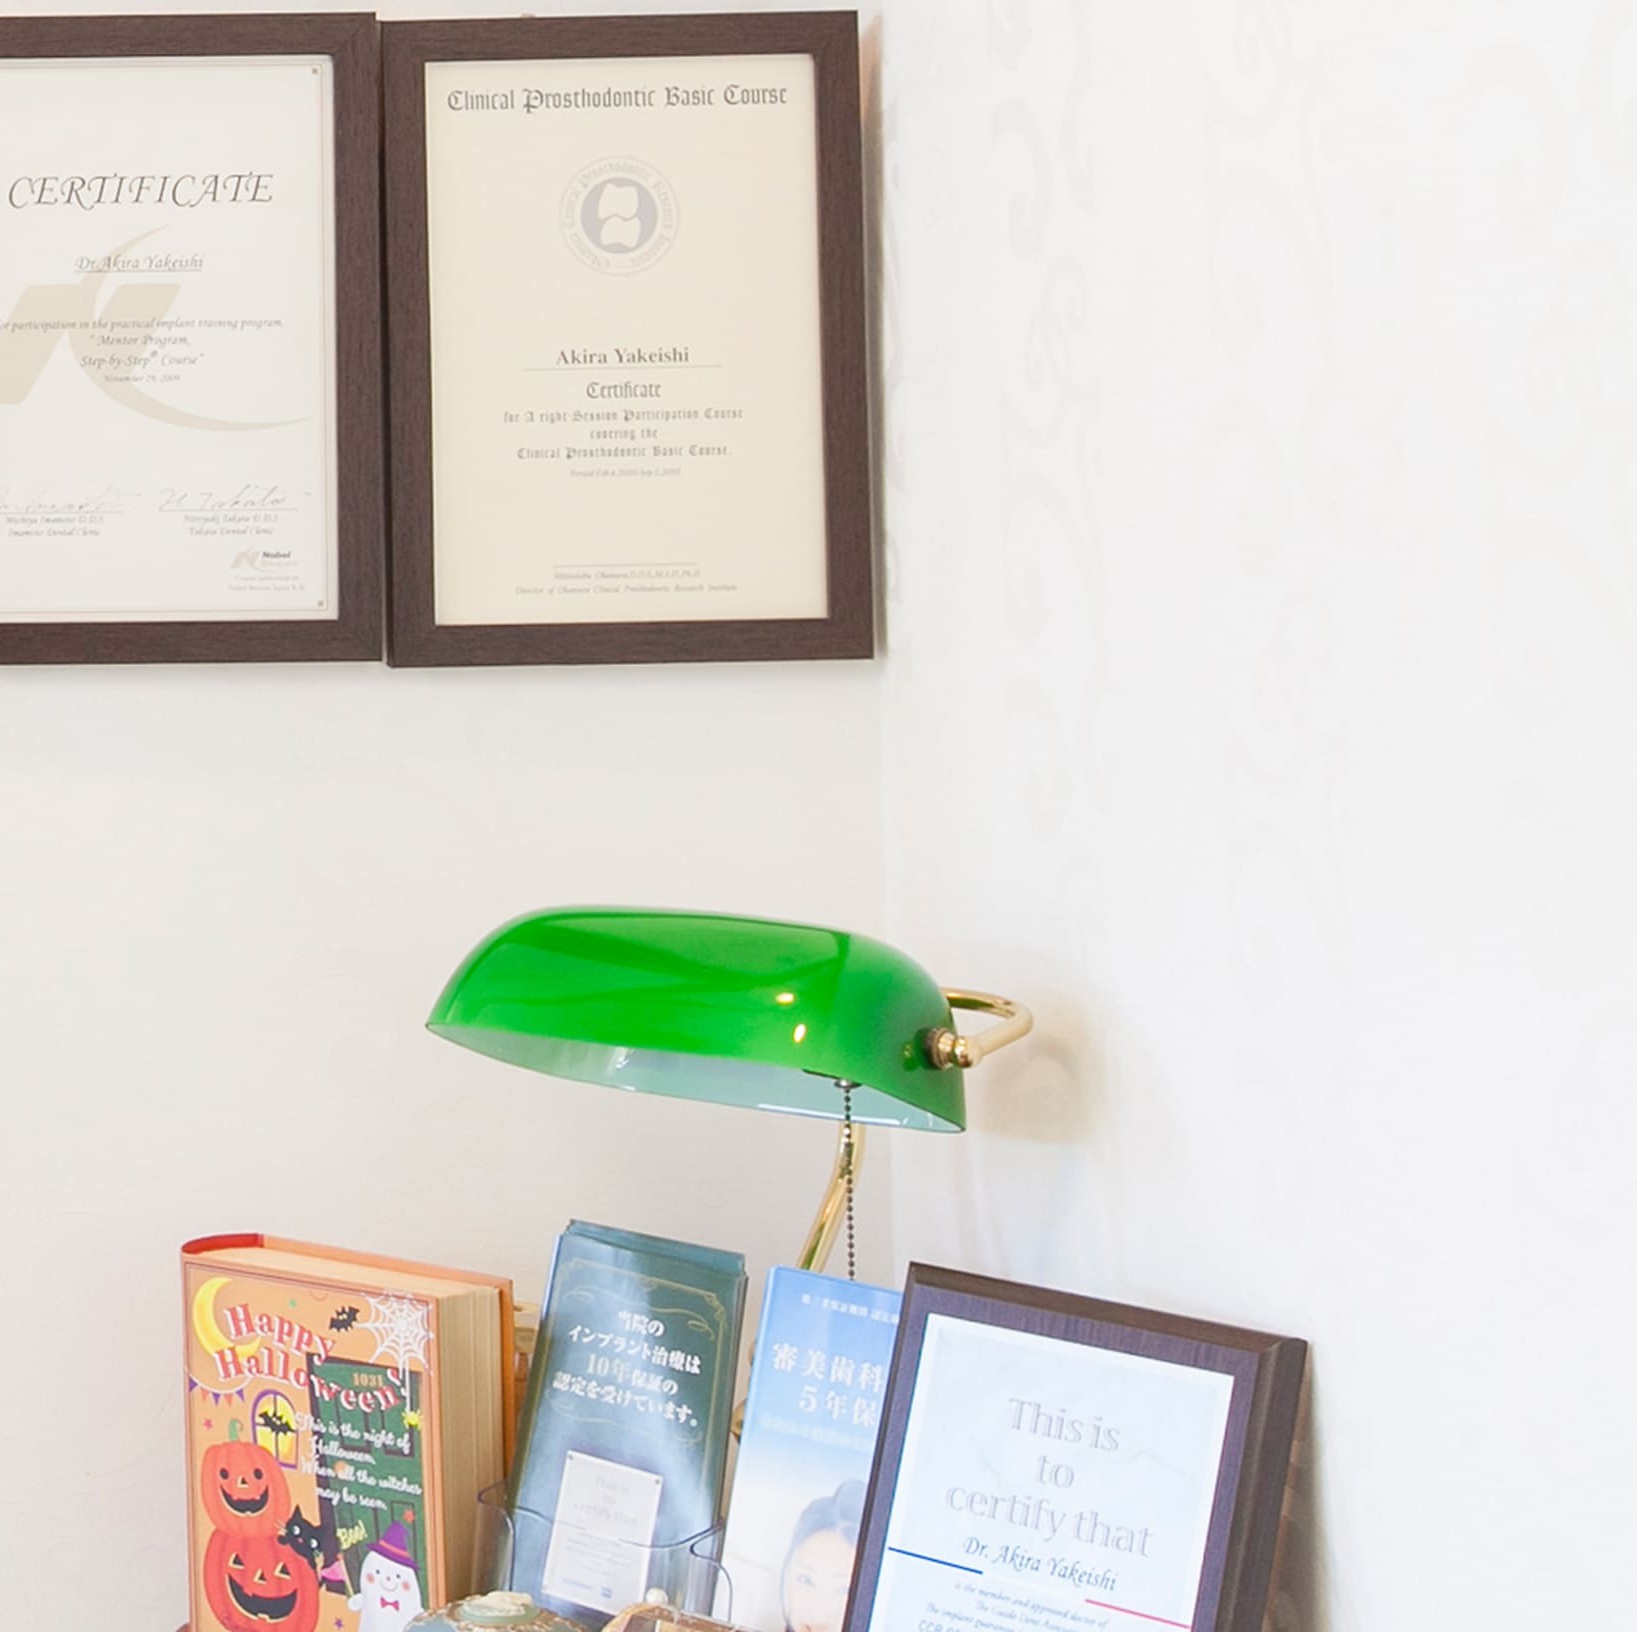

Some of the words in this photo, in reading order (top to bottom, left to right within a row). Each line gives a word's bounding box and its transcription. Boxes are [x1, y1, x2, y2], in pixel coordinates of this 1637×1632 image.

[447, 89, 515, 113] Clinical
[523, 88, 655, 115] Prosthodontic
[665, 86, 714, 108] Basic
[724, 85, 788, 106] Course
[8, 172, 274, 209] CERTIFICATE
[146, 254, 203, 270] Yakeishi
[556, 349, 608, 365] Akira
[615, 347, 689, 364] Yakeishi
[586, 381, 662, 400] Certificate
[224, 1303, 337, 1364] Happy
[569, 1325, 701, 1374] インプラント治療は
[773, 1343, 883, 1392] 審美歯科
[553, 1371, 698, 1427] 認定を受けています。
[1008, 1397, 1083, 1443] This
[1090, 1416, 1120, 1451] is
[1038, 1455, 1074, 1488] to
[337, 1520, 367, 1550] Boo!
[946, 1487, 1065, 1542] certify
[1074, 1511, 1153, 1556] that
[964, 1537, 988, 1558] Dr.
[992, 1545, 1040, 1572] Akira
[1047, 1558, 1117, 1591] Yakeishi
